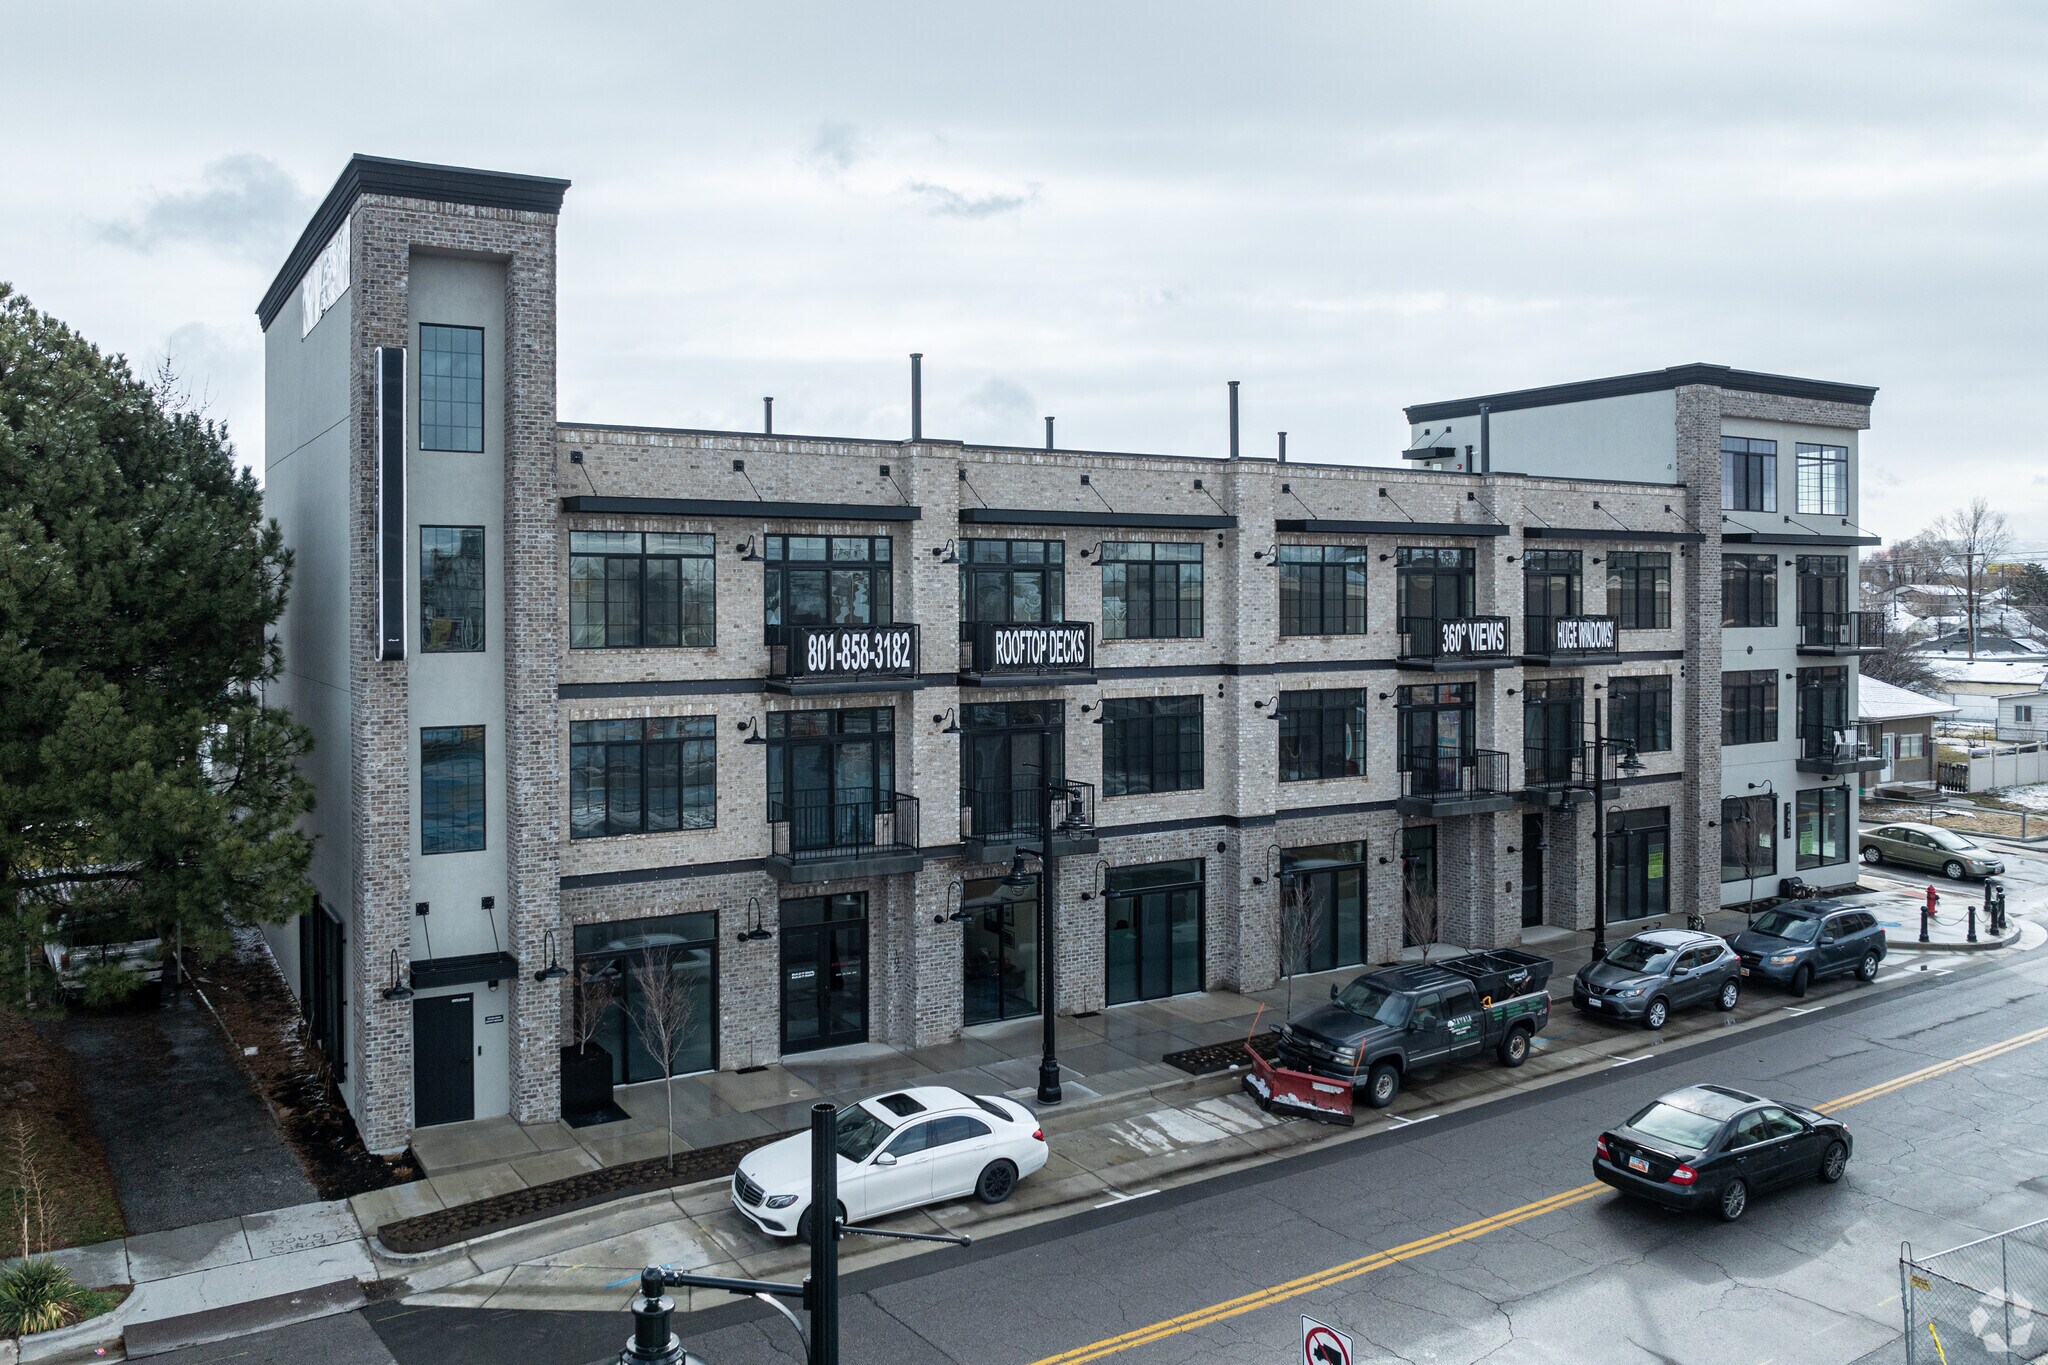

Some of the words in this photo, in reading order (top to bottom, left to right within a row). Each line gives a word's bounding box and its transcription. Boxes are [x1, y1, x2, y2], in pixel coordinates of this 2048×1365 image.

[995, 630, 1047, 665] ROOFTOP
[1049, 629, 1085, 663] DECKS
[1468, 622, 1504, 651] VIEWS
[1557, 621, 1577, 649] HUGE
[1578, 621, 1614, 648] WINDOWS!
[807, 632, 911, 672] 801-858-3182
